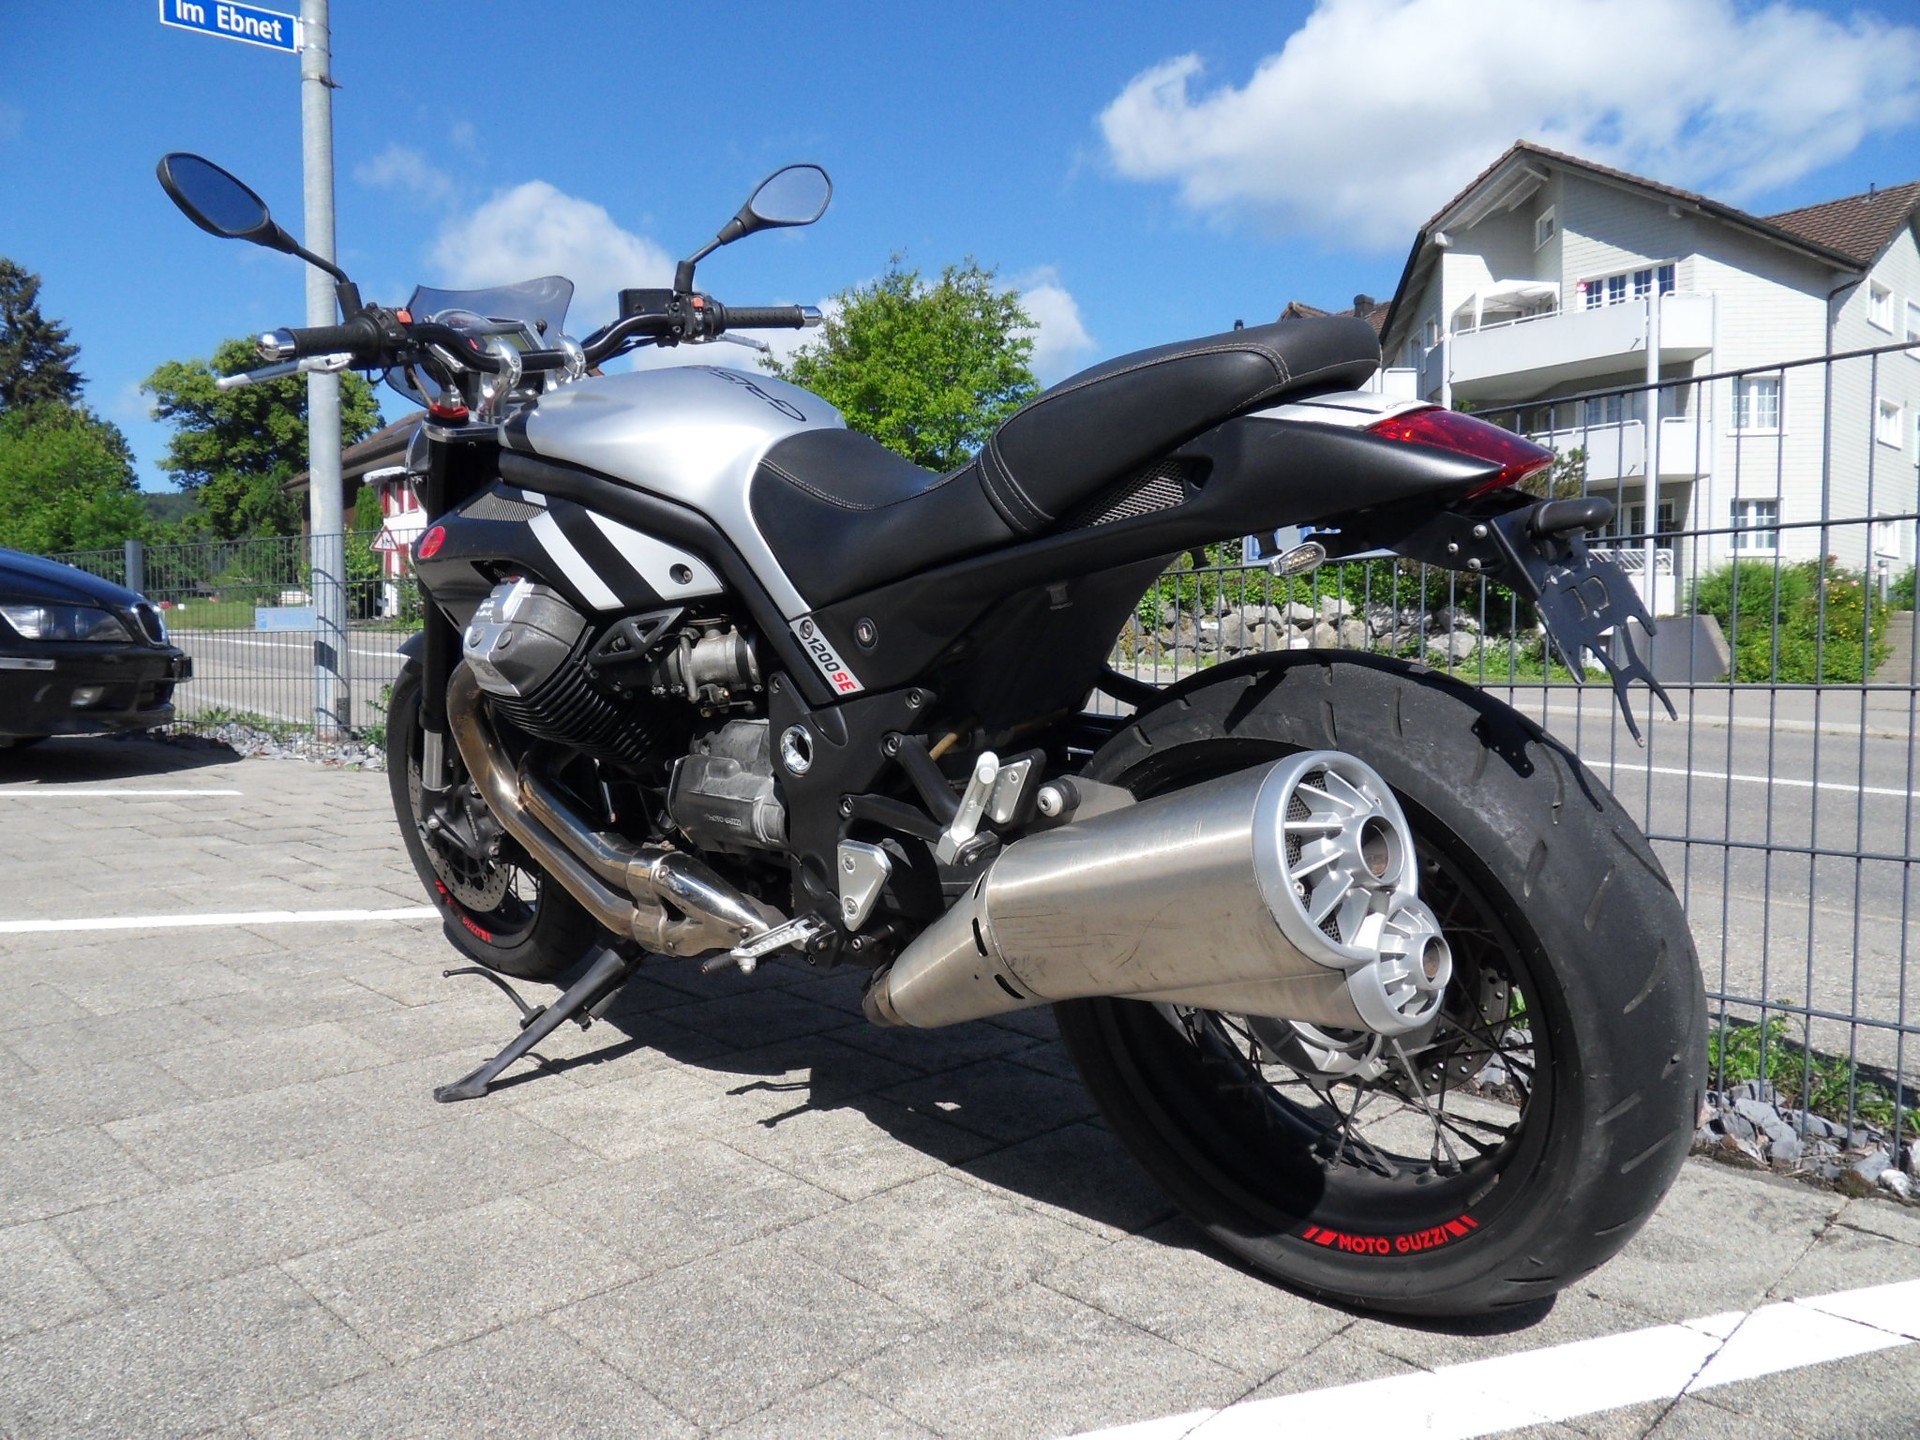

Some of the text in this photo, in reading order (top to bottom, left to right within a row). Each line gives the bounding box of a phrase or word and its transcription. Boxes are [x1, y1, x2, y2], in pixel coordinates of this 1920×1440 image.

[176, 0, 282, 41] Im Ebnet
[1338, 1227, 1448, 1254] MOTO GUZZI
